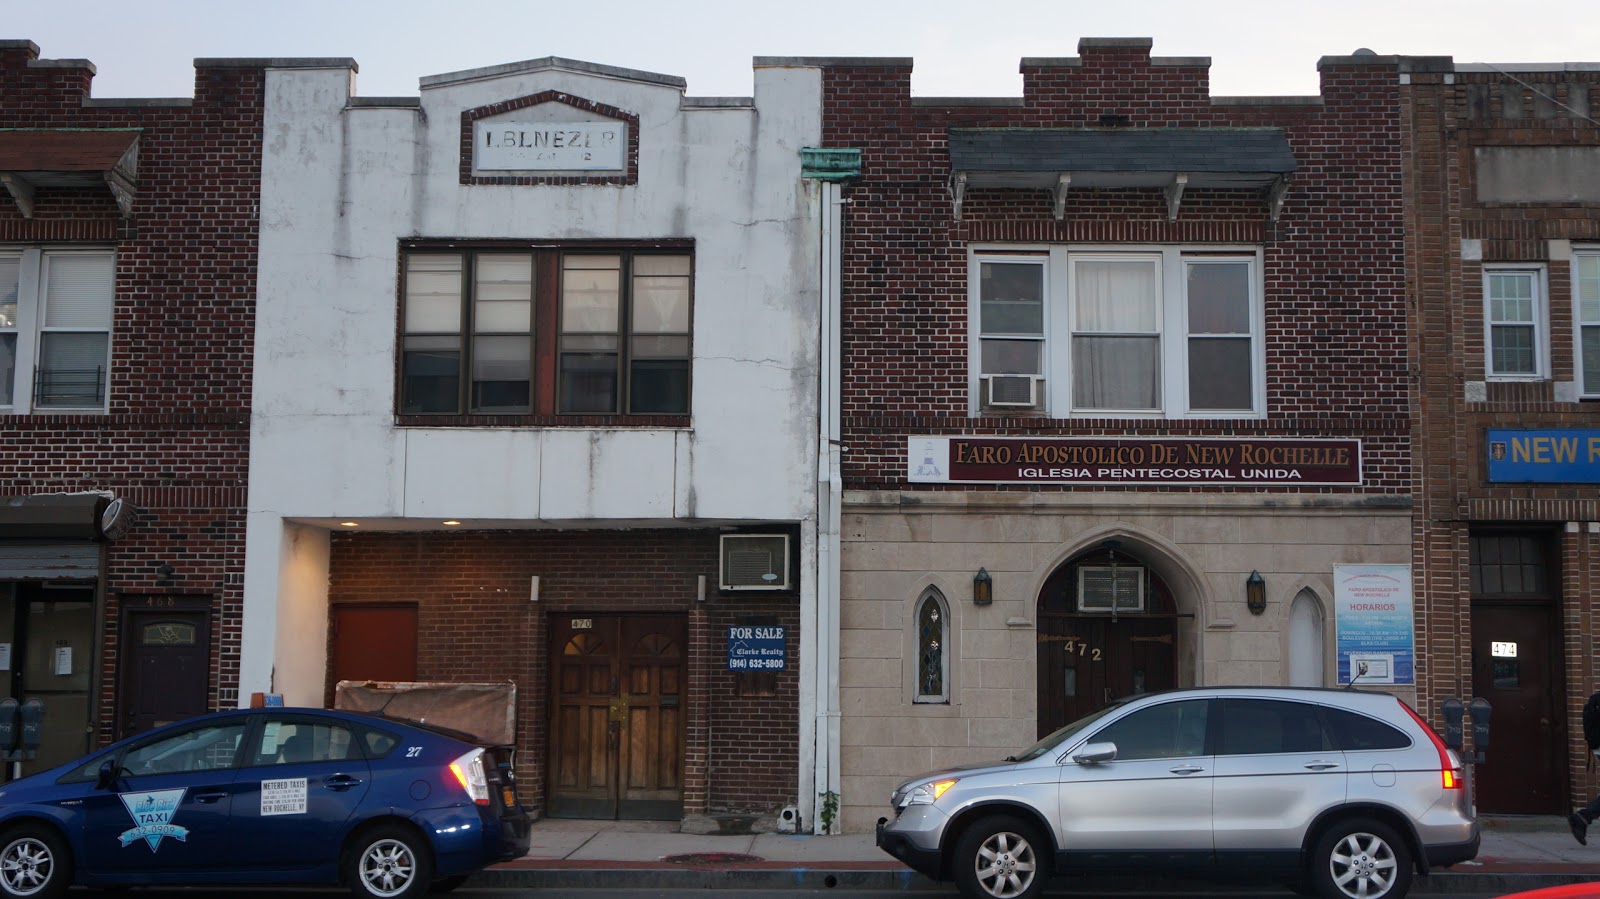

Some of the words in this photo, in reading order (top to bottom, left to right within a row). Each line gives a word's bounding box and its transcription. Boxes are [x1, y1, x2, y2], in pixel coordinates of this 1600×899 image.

[955, 442, 1011, 465] FARO
[1015, 442, 1145, 465] APOSTOLICO
[1185, 443, 1234, 465] NEW
[1239, 443, 1349, 466] ROCHELLE
[1511, 437, 1578, 464] NEW
[1018, 468, 1092, 478] IGLESIA
[1098, 468, 1236, 479] PENTECOSTAL
[1241, 468, 1302, 479] UNIDA
[146, 596, 175, 607] 468
[1350, 603, 1395, 611] HORARIOS
[572, 619, 591, 628] 470
[730, 627, 753, 639] FOR
[755, 627, 784, 639] SALE
[760, 648, 784, 657] Realty
[1064, 640, 1102, 661] 472
[1493, 643, 1514, 655] 474
[729, 658, 747, 668] (914)
[749, 658, 784, 668] 632-5800
[405, 746, 423, 758] 27
[263, 782, 288, 790] METERED
[290, 780, 305, 788] TAXIS
[135, 799, 155, 813] Blue
[156, 797, 176, 811] Bird
[262, 805, 272, 813] NEW
[140, 812, 168, 824] TAXI
[130, 825, 175, 838] 632-0909
